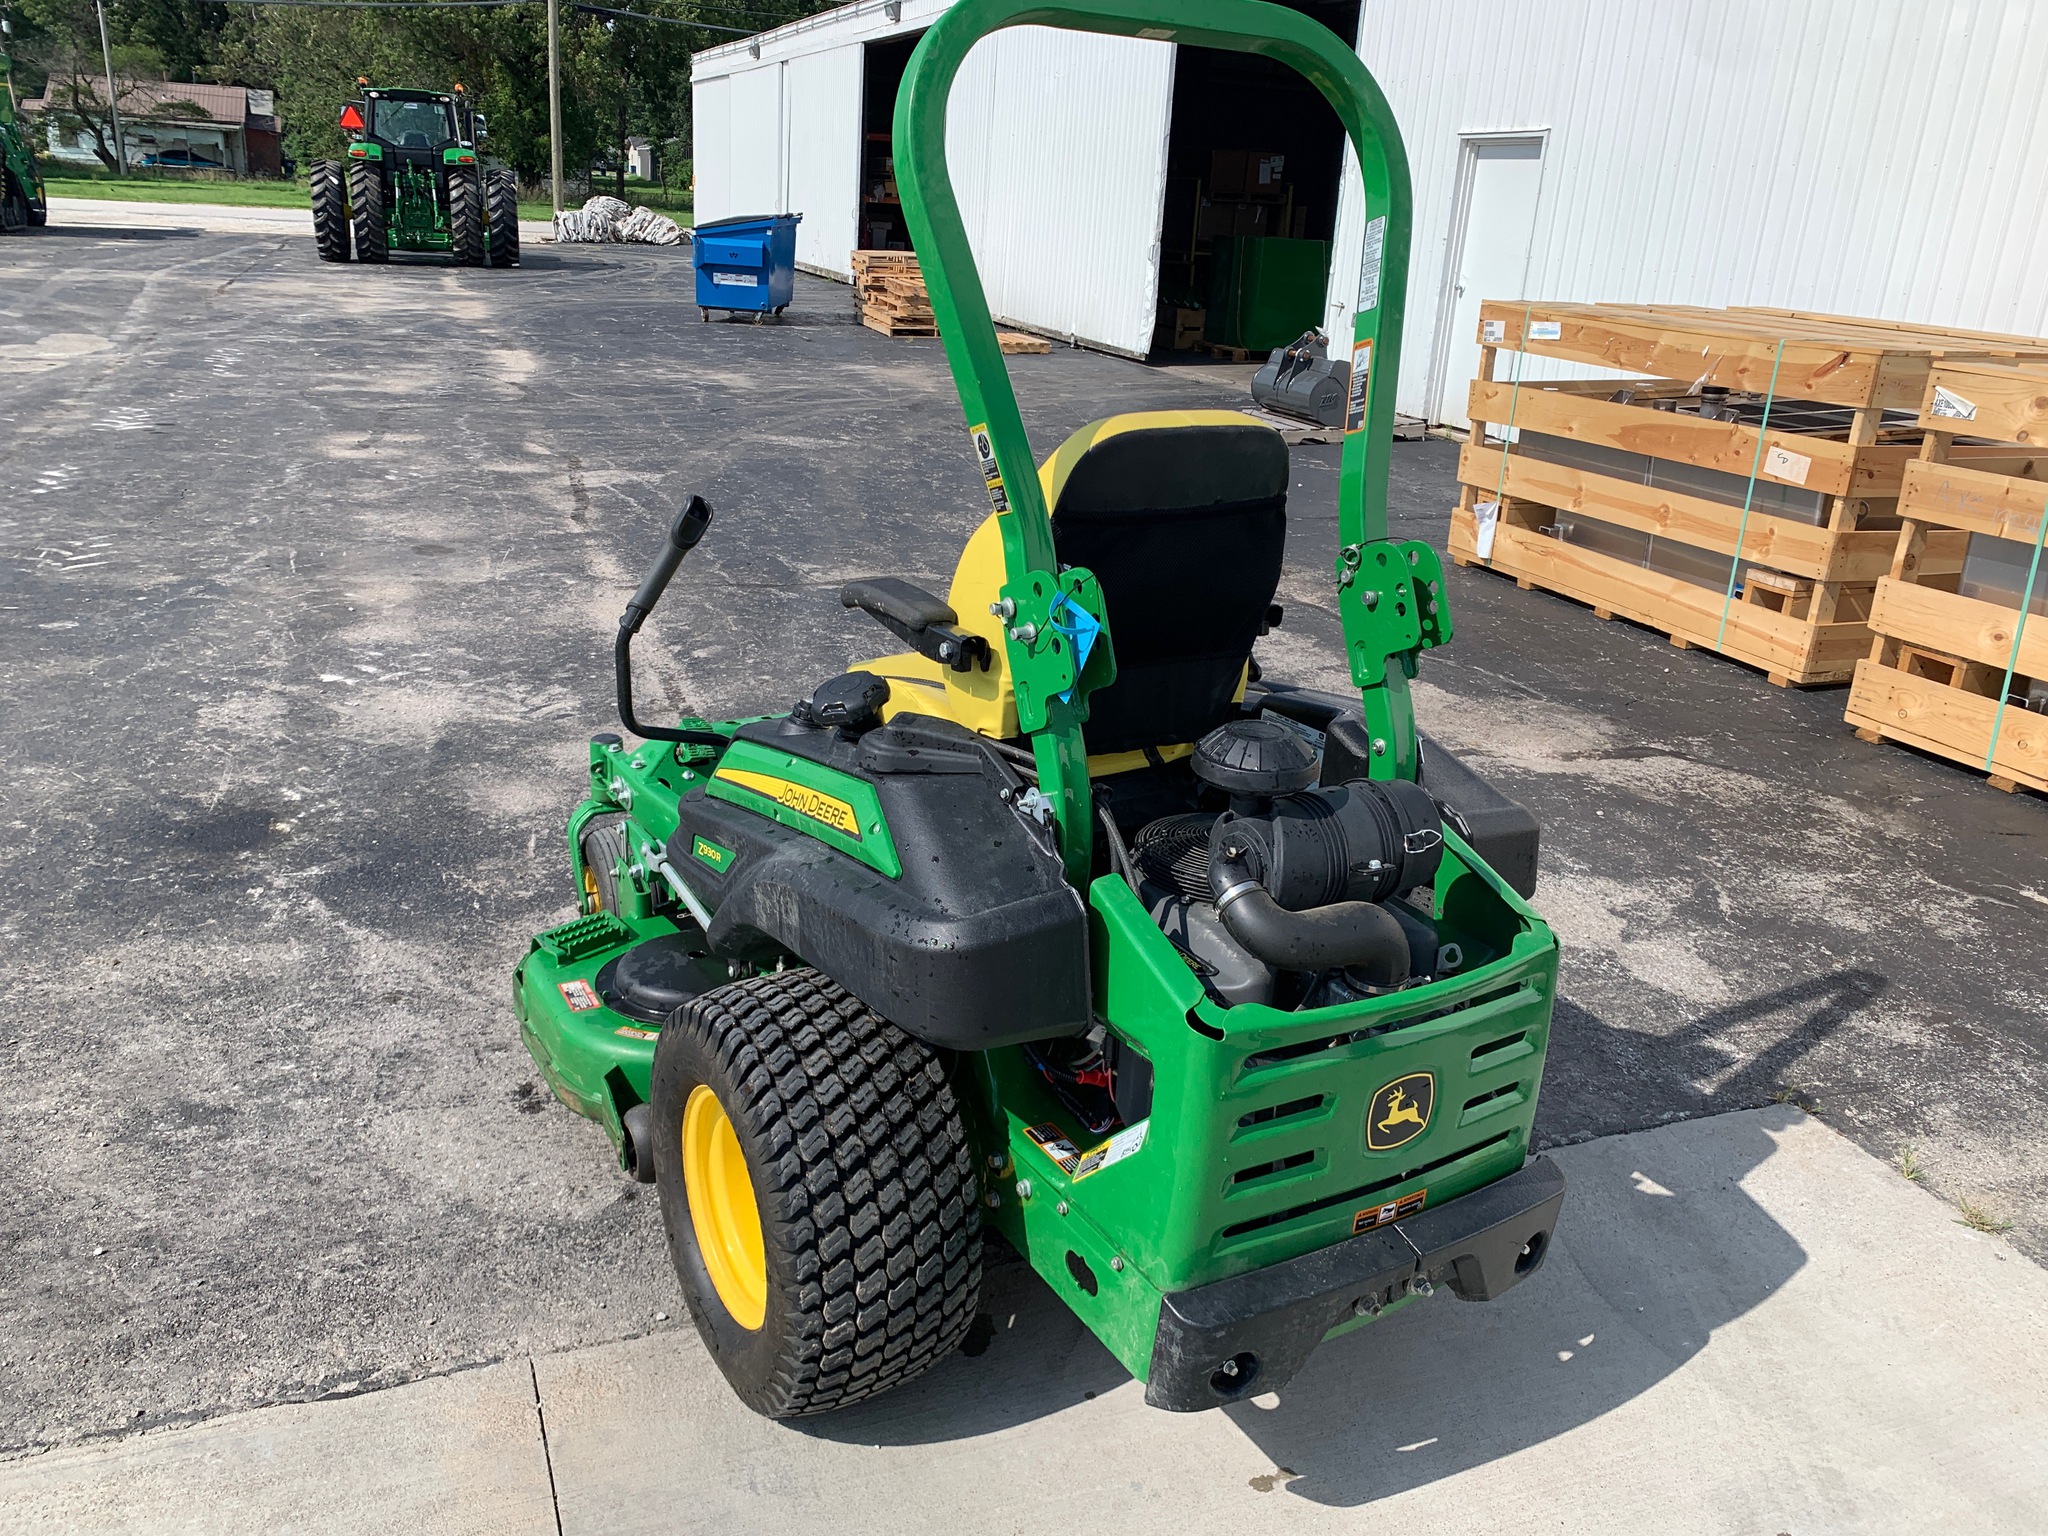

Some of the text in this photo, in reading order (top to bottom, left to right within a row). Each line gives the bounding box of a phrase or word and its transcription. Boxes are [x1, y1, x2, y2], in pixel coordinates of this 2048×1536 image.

[778, 783, 849, 827] JOHN DEERE
[698, 841, 722, 863] Z930R
